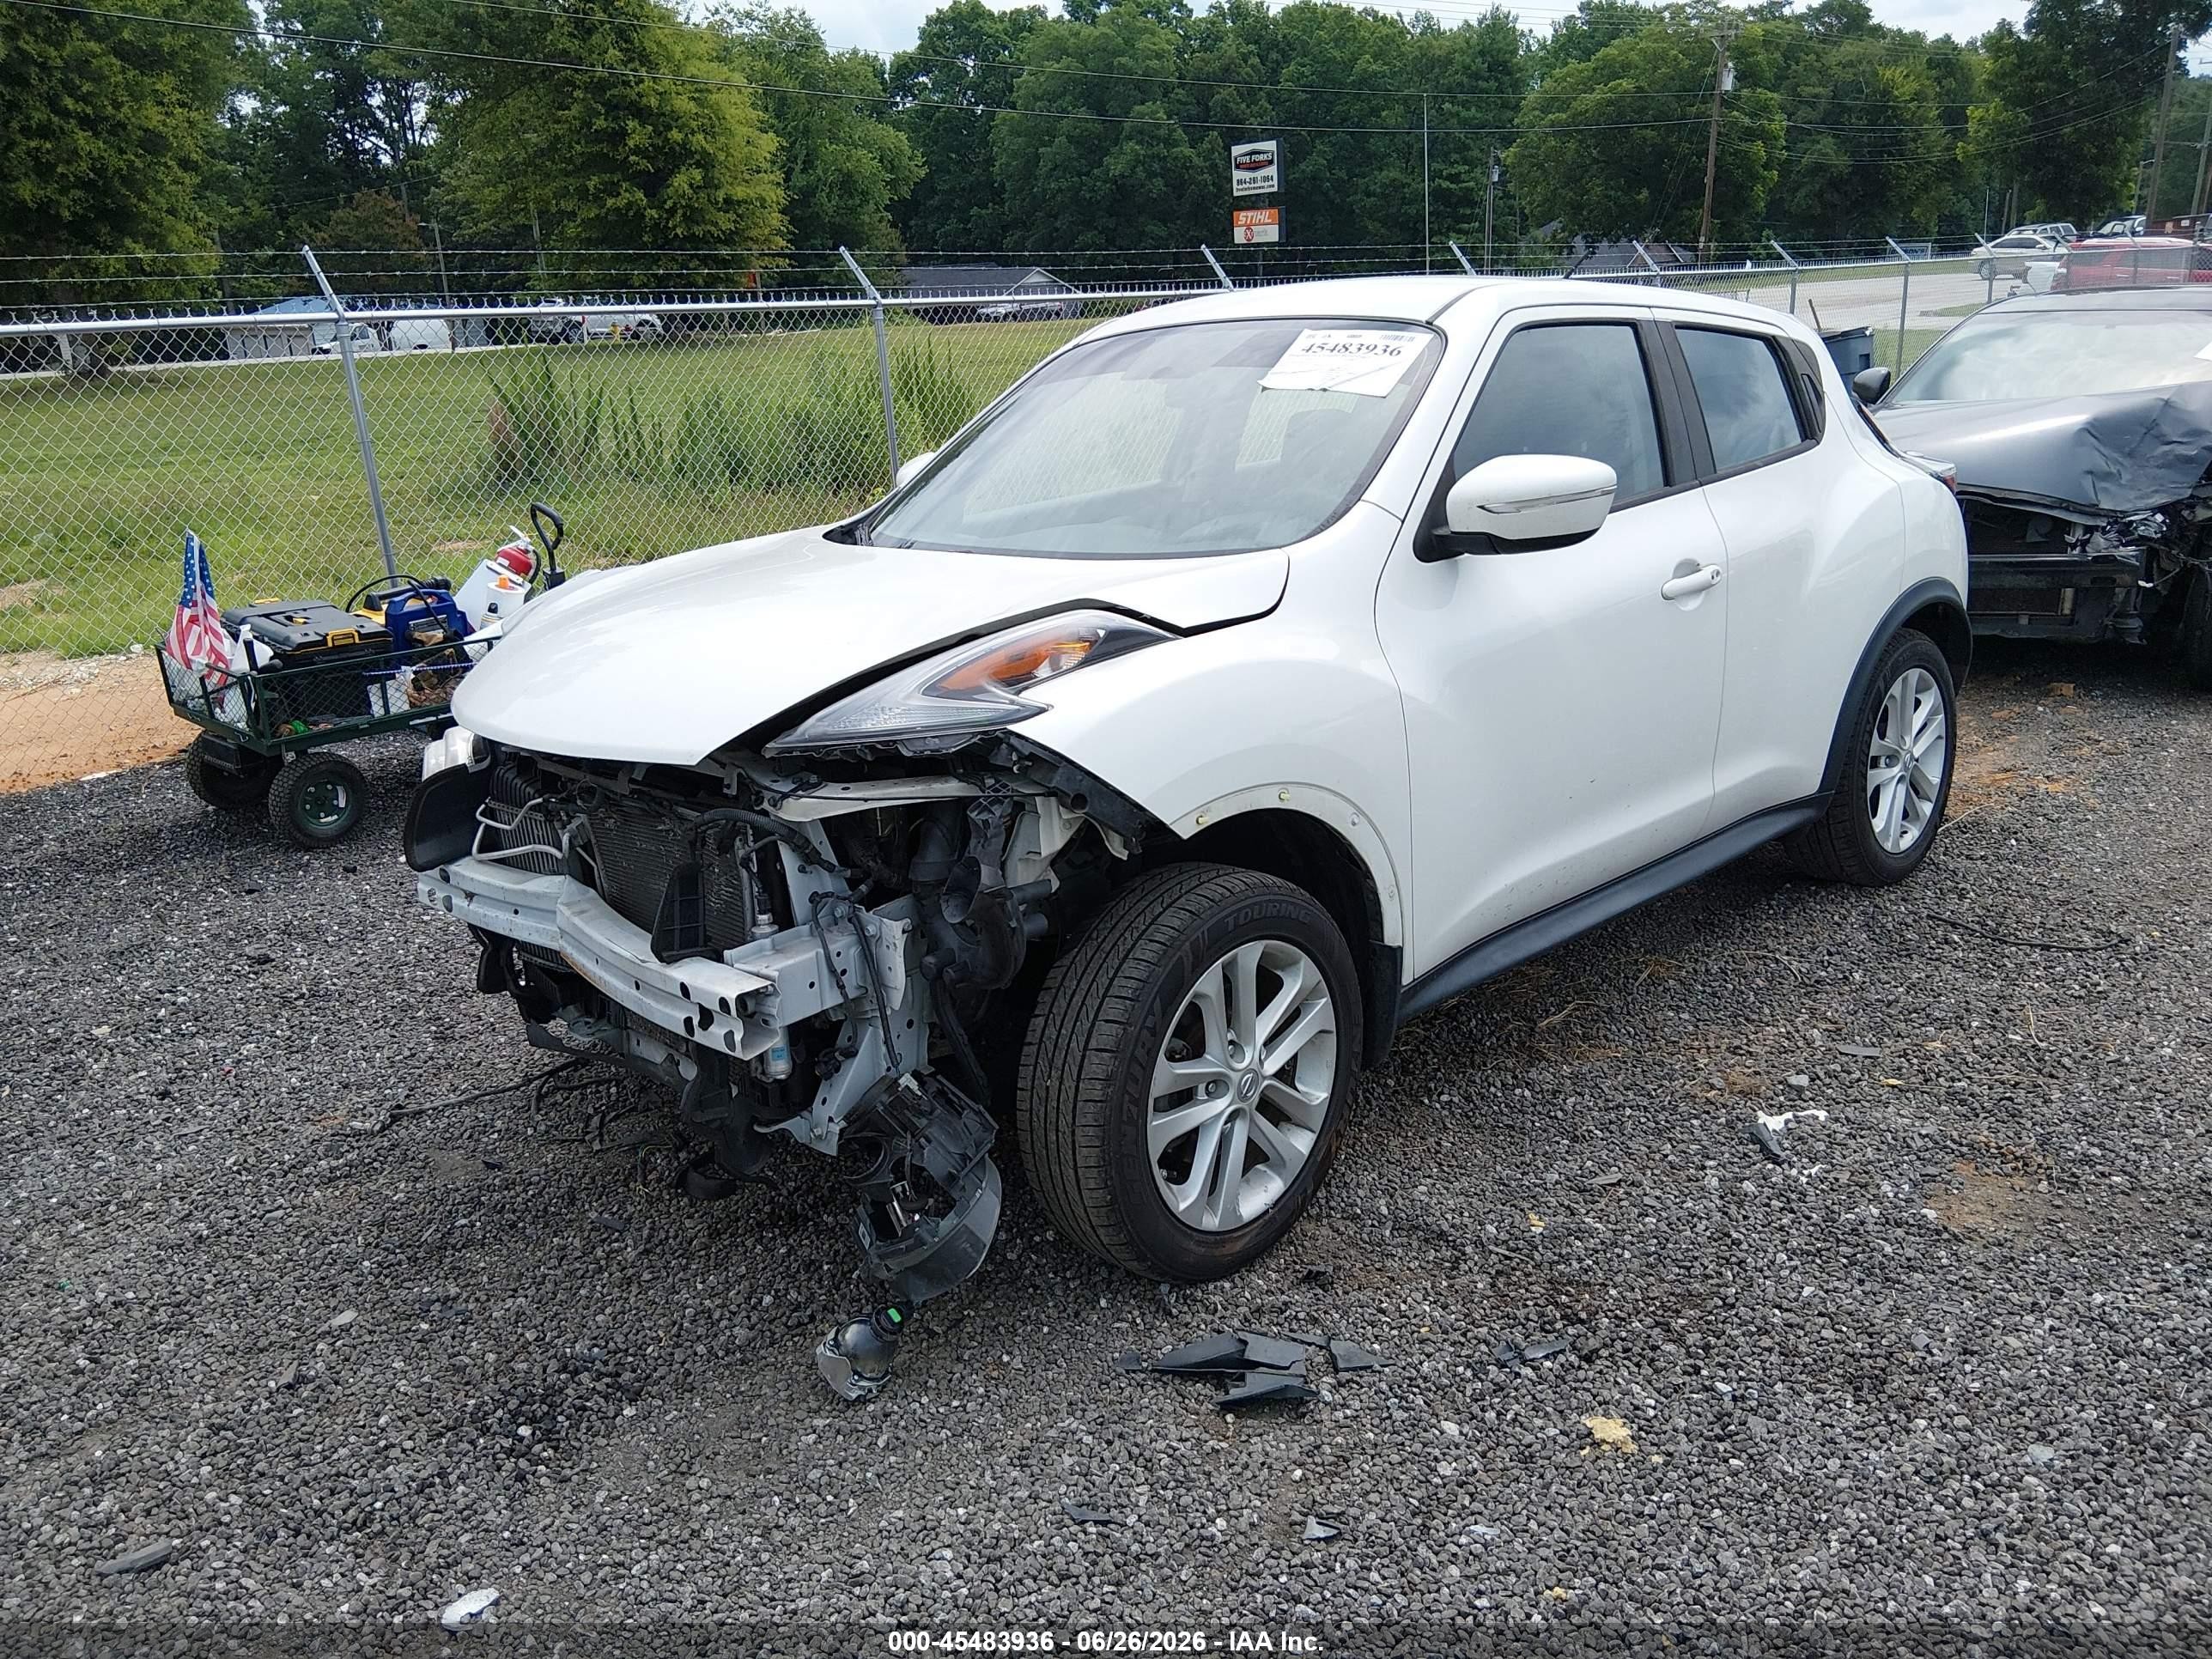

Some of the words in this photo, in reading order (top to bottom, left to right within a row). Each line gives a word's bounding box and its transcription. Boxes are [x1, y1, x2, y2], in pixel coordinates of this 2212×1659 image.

[1237, 155, 1251, 164] FIVE
[1251, 153, 1273, 162] FORKS
[1237, 210, 1273, 225] STIHL
[1300, 341, 1405, 357] 45483936
[1223, 902, 1312, 933] TOURING
